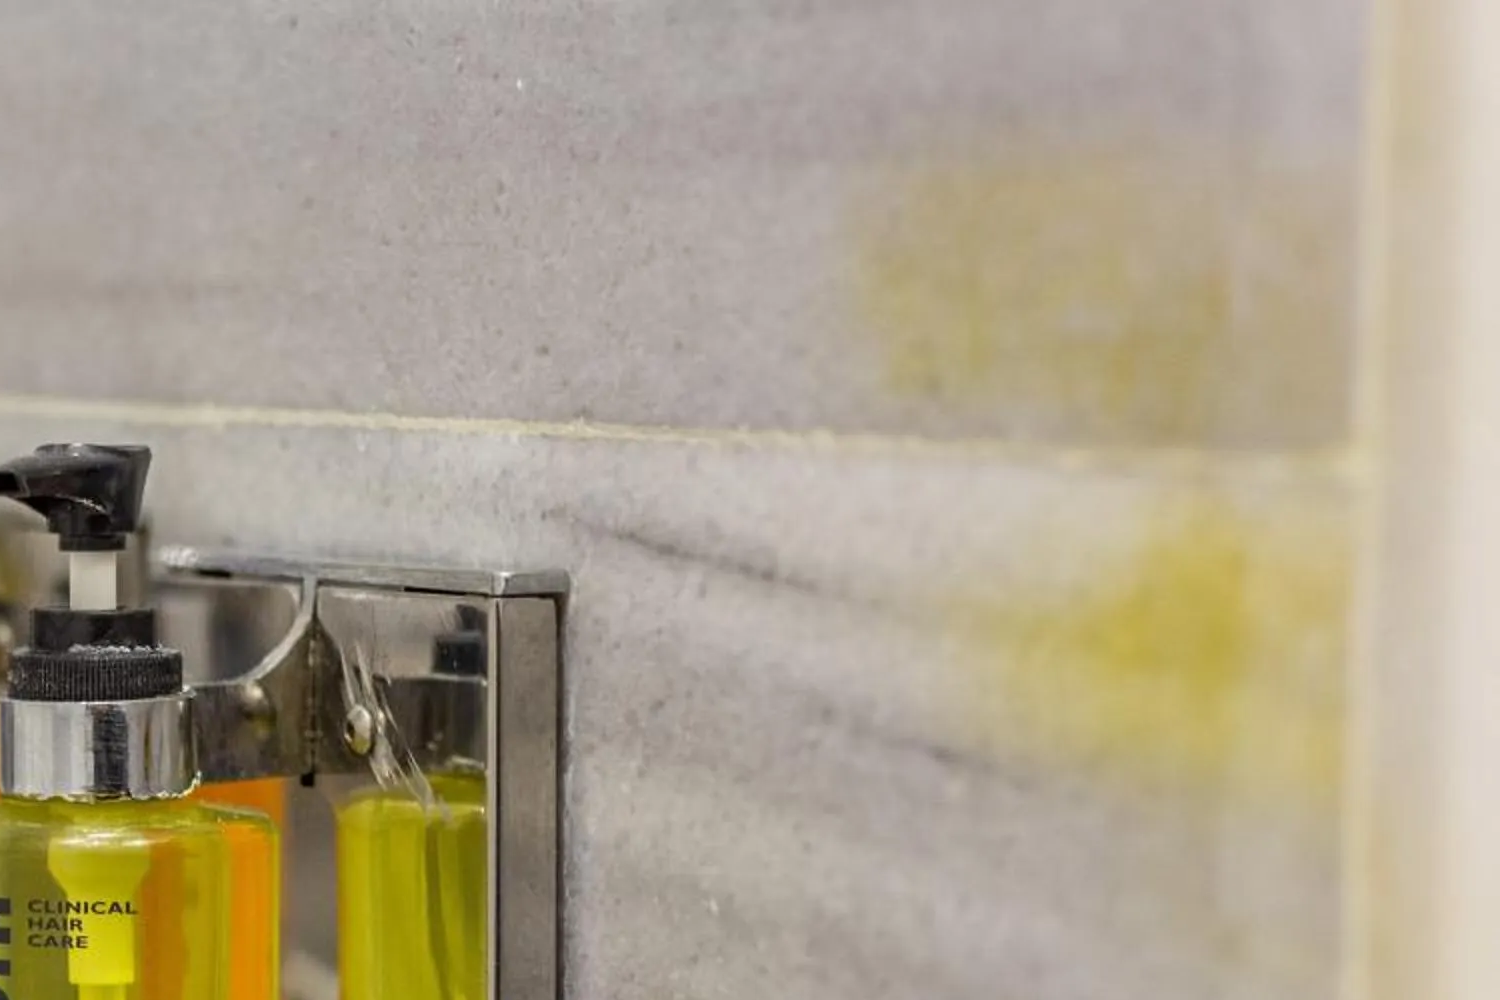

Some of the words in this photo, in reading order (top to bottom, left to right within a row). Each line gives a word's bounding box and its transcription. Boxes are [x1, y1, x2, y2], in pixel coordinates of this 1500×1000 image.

[27, 899, 139, 915] CLINICAL
[27, 917, 83, 932] HAIR
[27, 933, 89, 949] CARE
